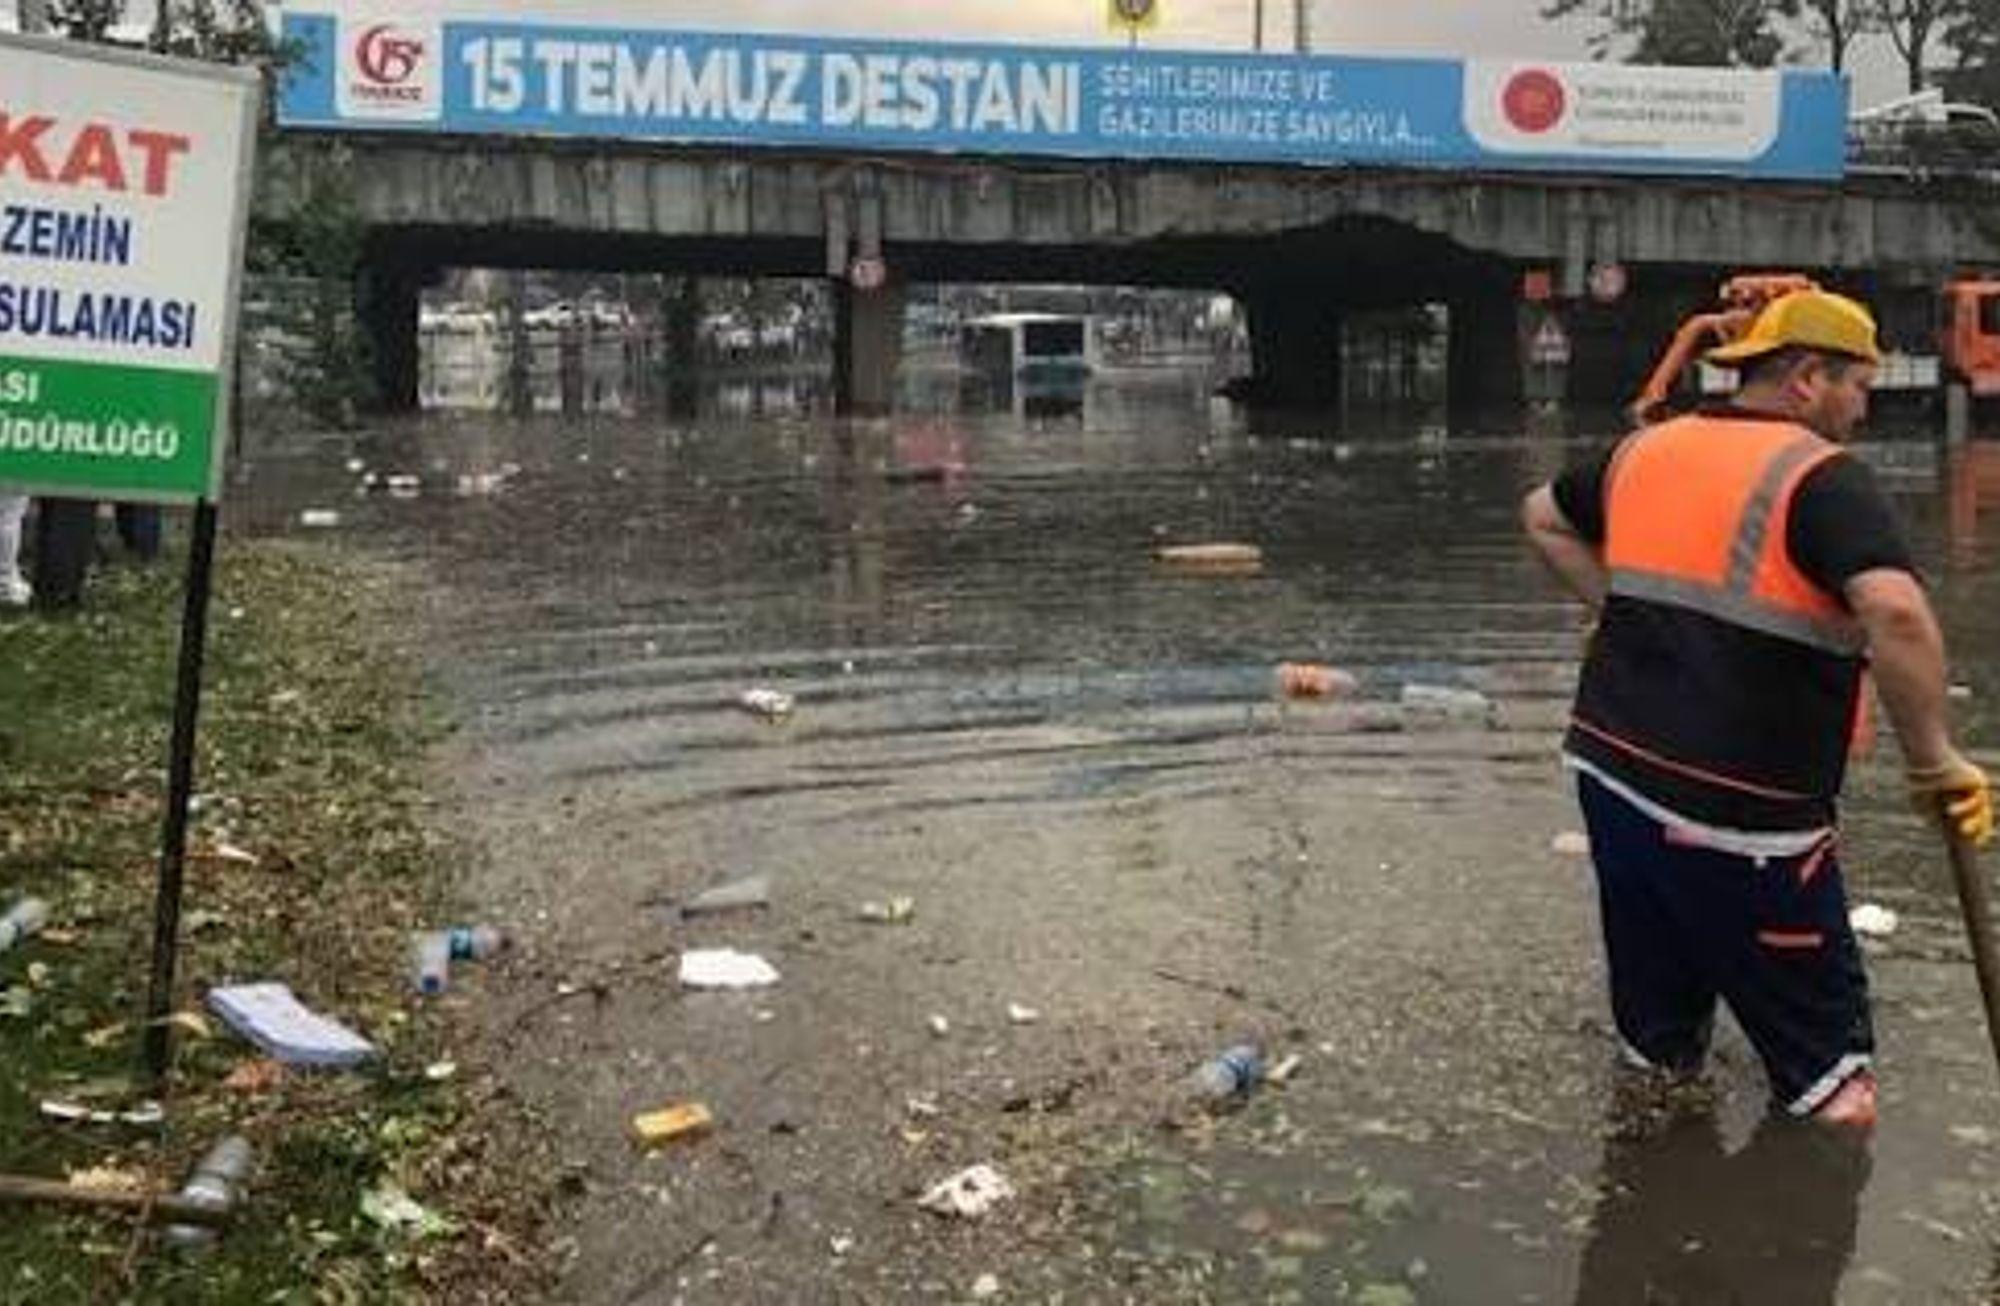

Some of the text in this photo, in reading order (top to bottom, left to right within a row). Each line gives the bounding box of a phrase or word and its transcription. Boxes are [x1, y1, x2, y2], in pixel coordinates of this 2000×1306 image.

[463, 37, 1081, 133] 15 TEMMUZ DESTANI
[1302, 70, 1337, 101] VE
[0, 112, 190, 196] KAT
[2, 203, 131, 264] ZEMİN
[0, 284, 196, 348] SULAMASI
[0, 371, 39, 402] SI
